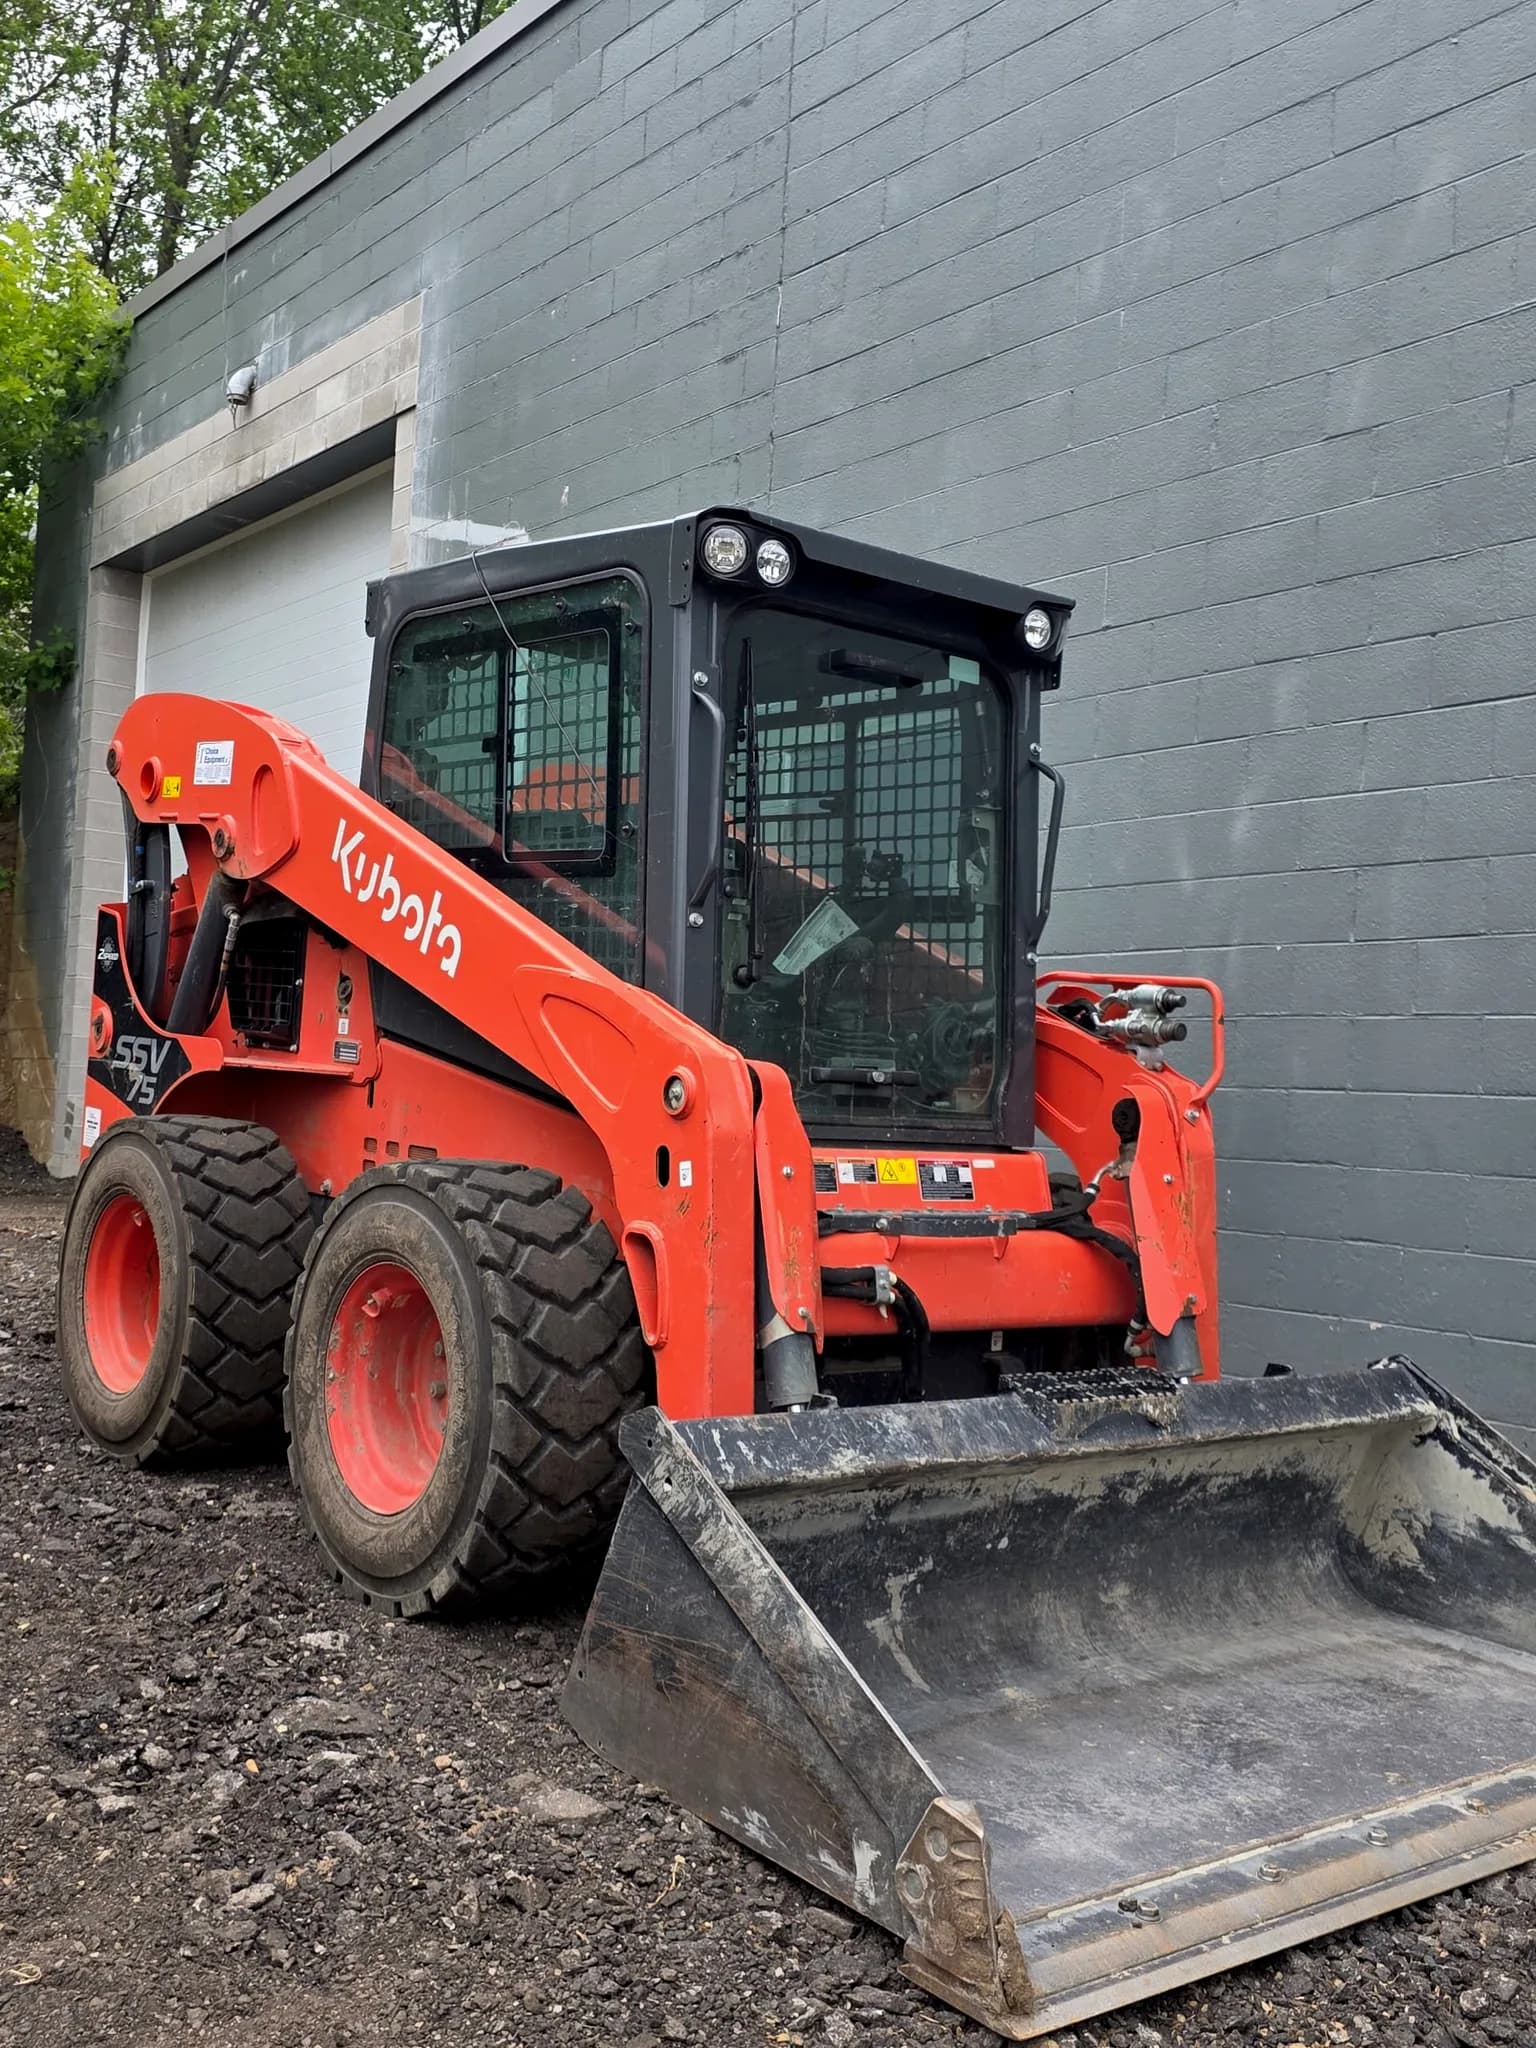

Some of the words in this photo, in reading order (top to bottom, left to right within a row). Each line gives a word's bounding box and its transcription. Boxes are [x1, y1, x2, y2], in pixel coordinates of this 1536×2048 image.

[331, 818, 462, 978] Kubota
[111, 1034, 172, 1073] SSV
[126, 1071, 157, 1104] 75
